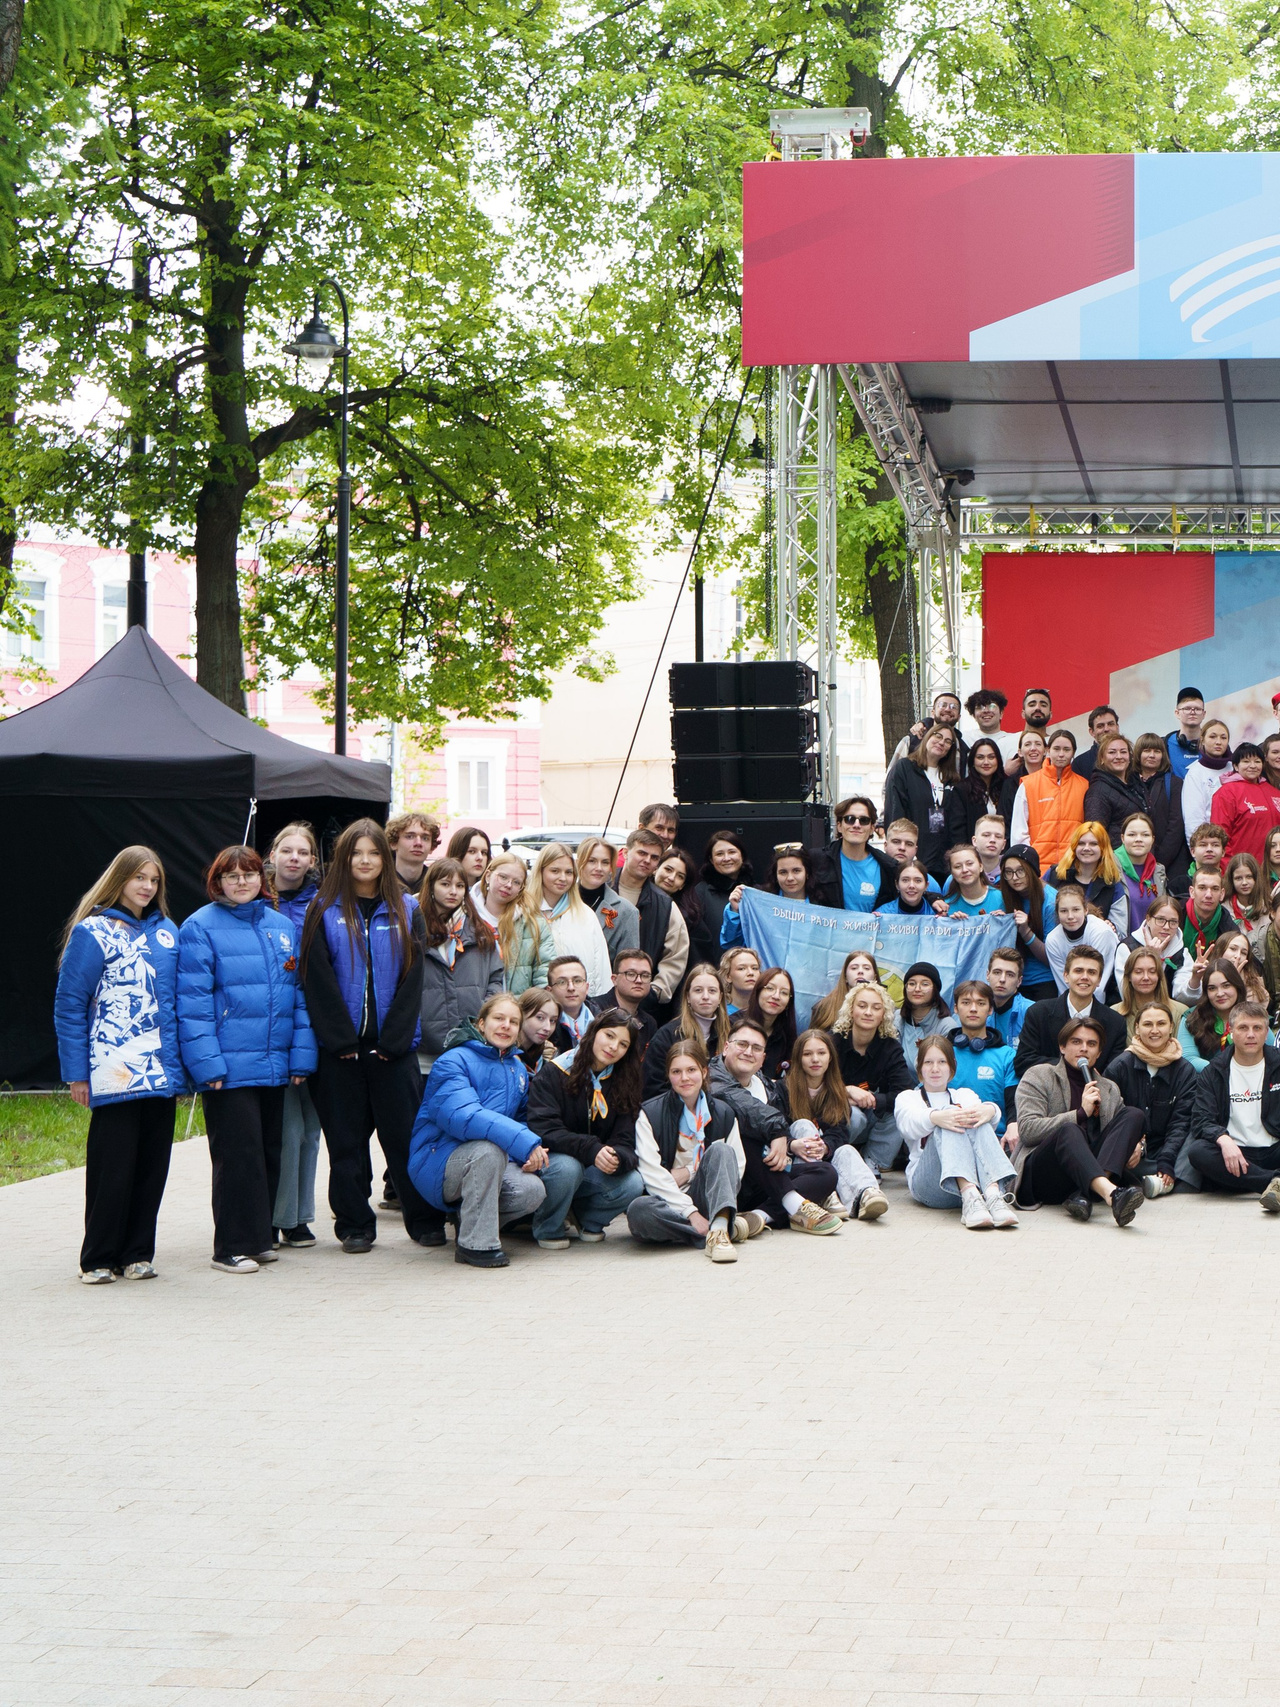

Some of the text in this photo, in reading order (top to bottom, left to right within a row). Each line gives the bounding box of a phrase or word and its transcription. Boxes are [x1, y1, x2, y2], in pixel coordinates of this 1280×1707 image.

[772, 906, 991, 937] ДЫШИ РАДИ ЖИЗНИ, ЖИВИ РАДИ ДЕТЕЙ
